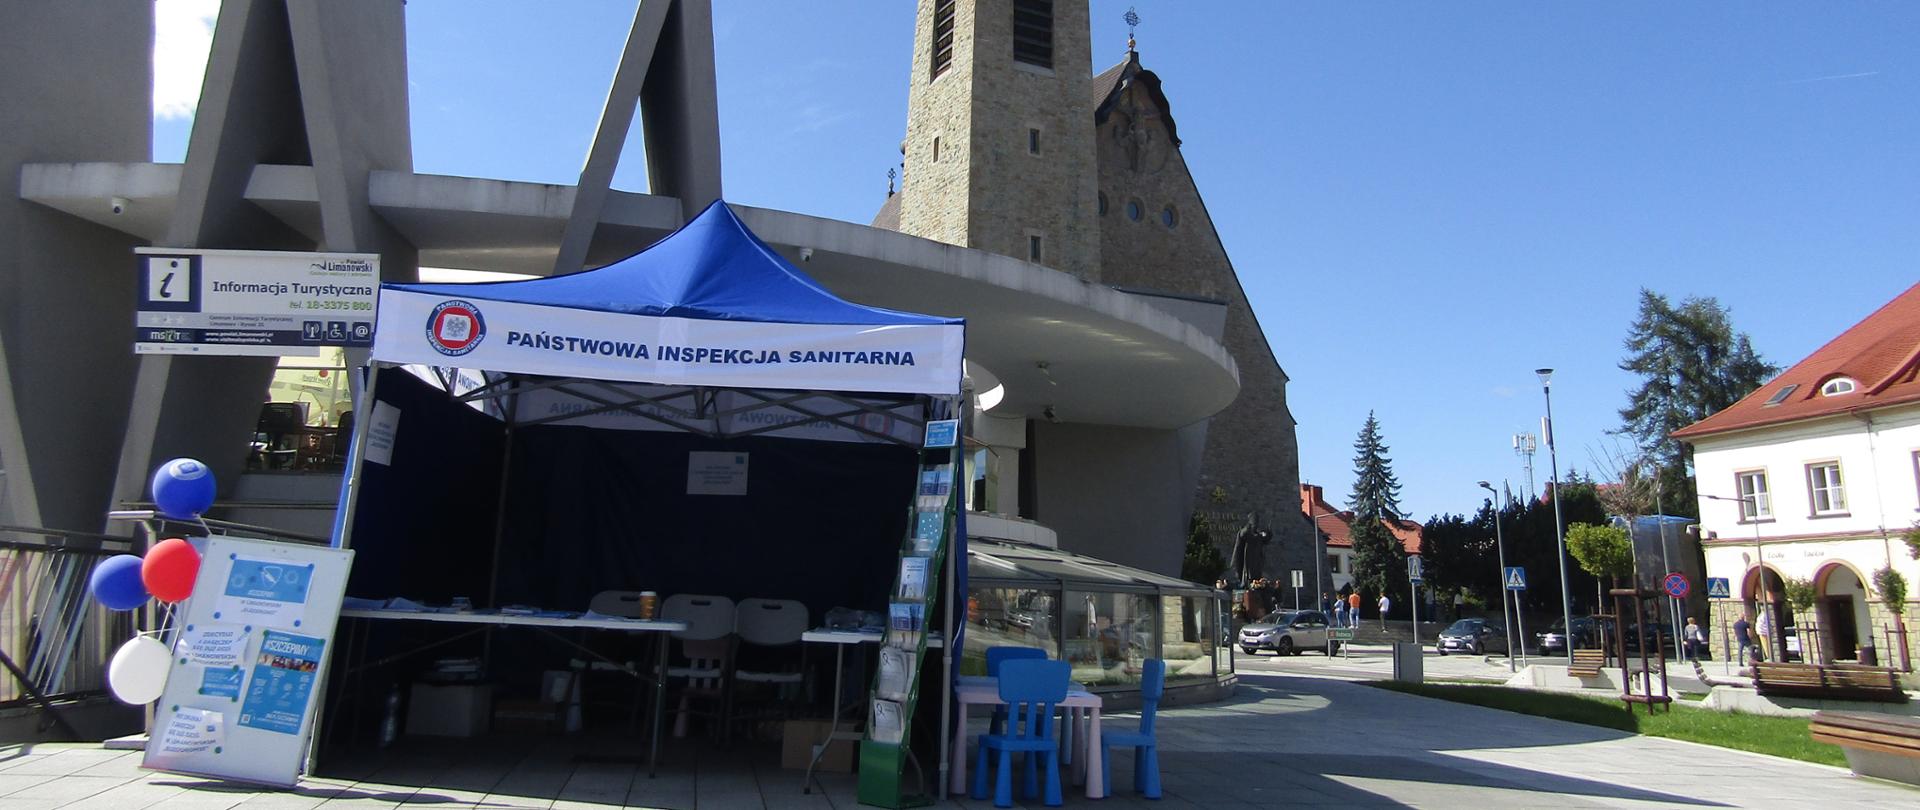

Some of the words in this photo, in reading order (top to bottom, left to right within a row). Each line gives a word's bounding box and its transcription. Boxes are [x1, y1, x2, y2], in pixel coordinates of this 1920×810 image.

[328, 262, 373, 272] Limanowski
[213, 281, 288, 296] Informacja
[292, 282, 373, 297] Turystyczna
[306, 300, 350, 310] 18-3375
[352, 301, 372, 311] 800
[506, 331, 650, 360] PAŃSTWOWA
[656, 345, 782, 364] INSPEKCJA
[788, 350, 916, 366] SANITARNA
